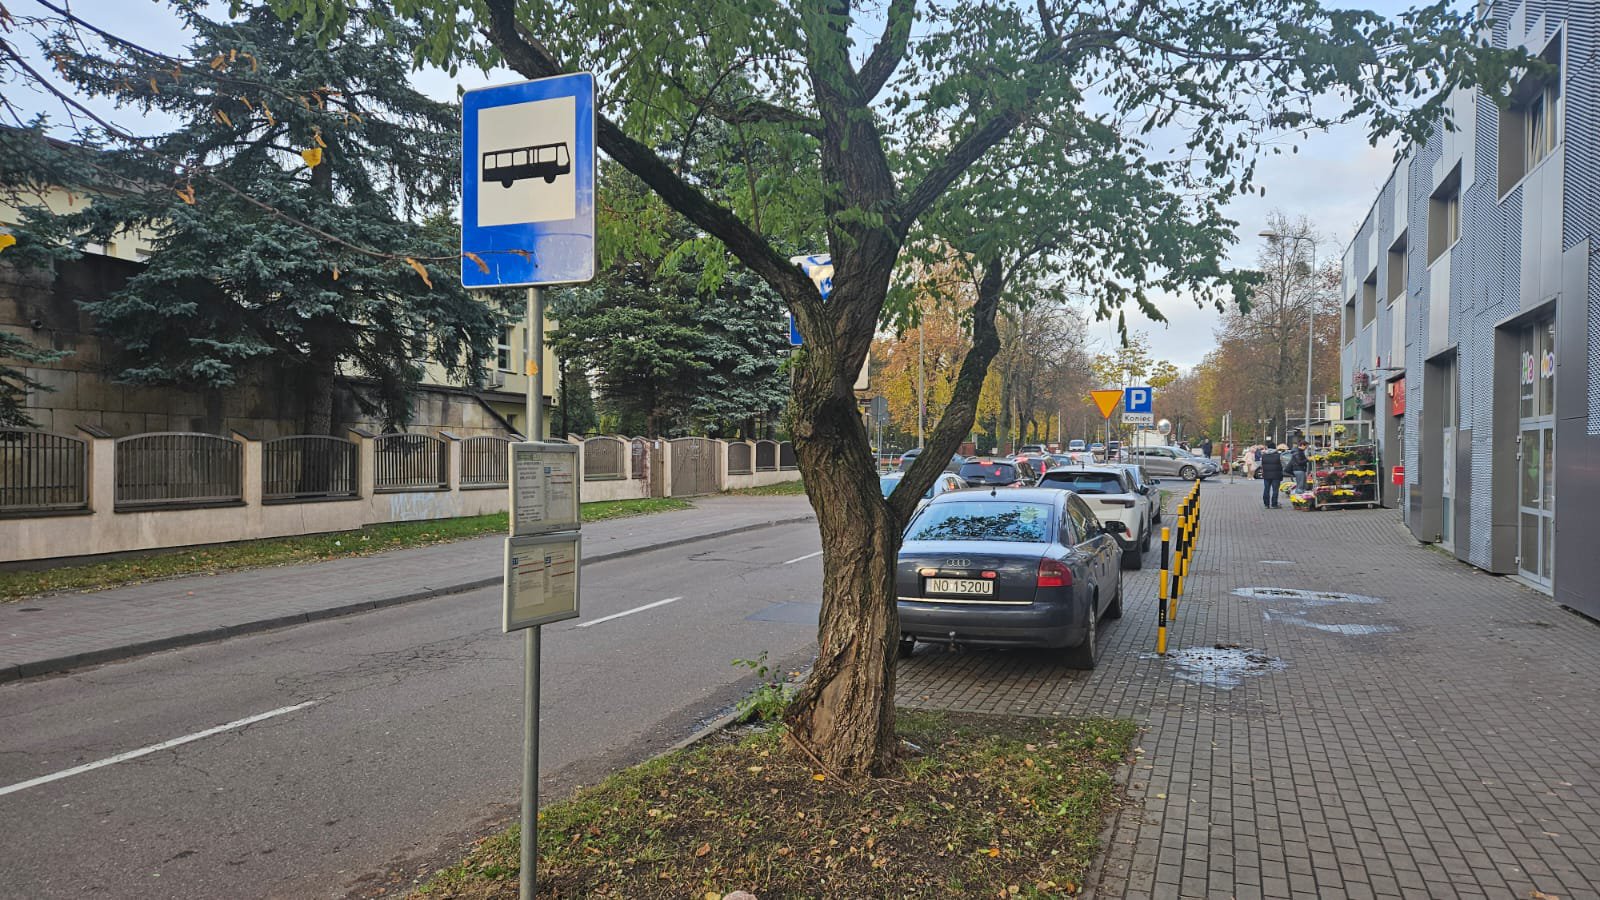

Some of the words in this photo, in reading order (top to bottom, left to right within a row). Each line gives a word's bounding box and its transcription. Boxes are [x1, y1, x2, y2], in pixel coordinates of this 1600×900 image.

[1131, 390, 1146, 409] P
[1124, 414, 1151, 422] Koniec
[933, 580, 949, 592] NO
[954, 581, 990, 594] 1520U
